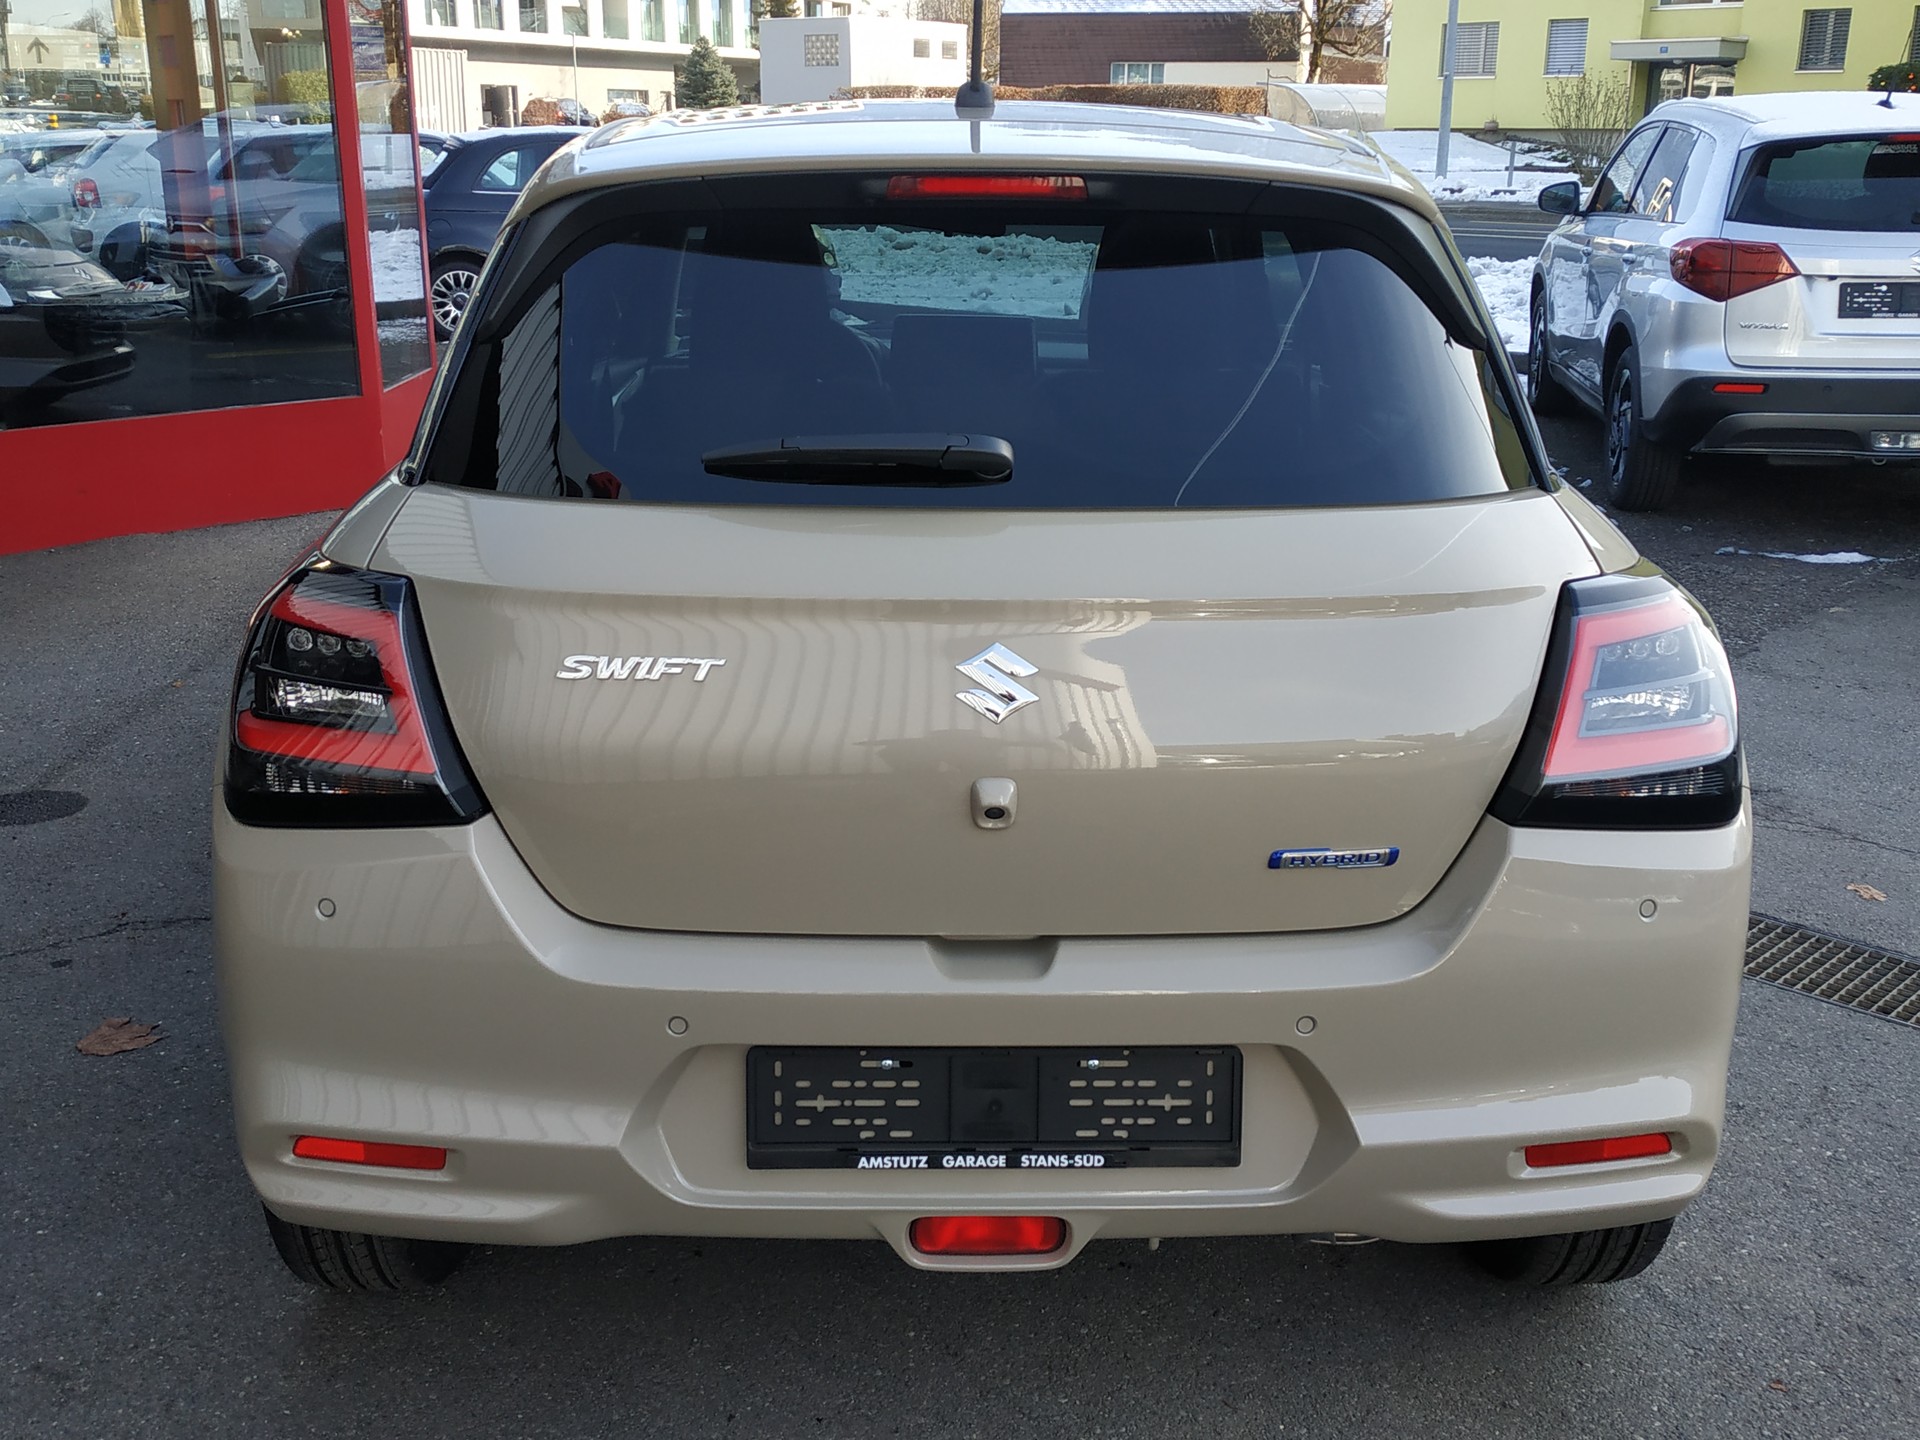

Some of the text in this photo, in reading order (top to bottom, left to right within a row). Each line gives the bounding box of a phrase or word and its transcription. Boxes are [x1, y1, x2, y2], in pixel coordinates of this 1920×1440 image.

[556, 654, 727, 682] SWIFT
[1288, 852, 1382, 868] HYBRID
[857, 1153, 1105, 1169] AMSTUTZ GARAGE STANS-SÜD
